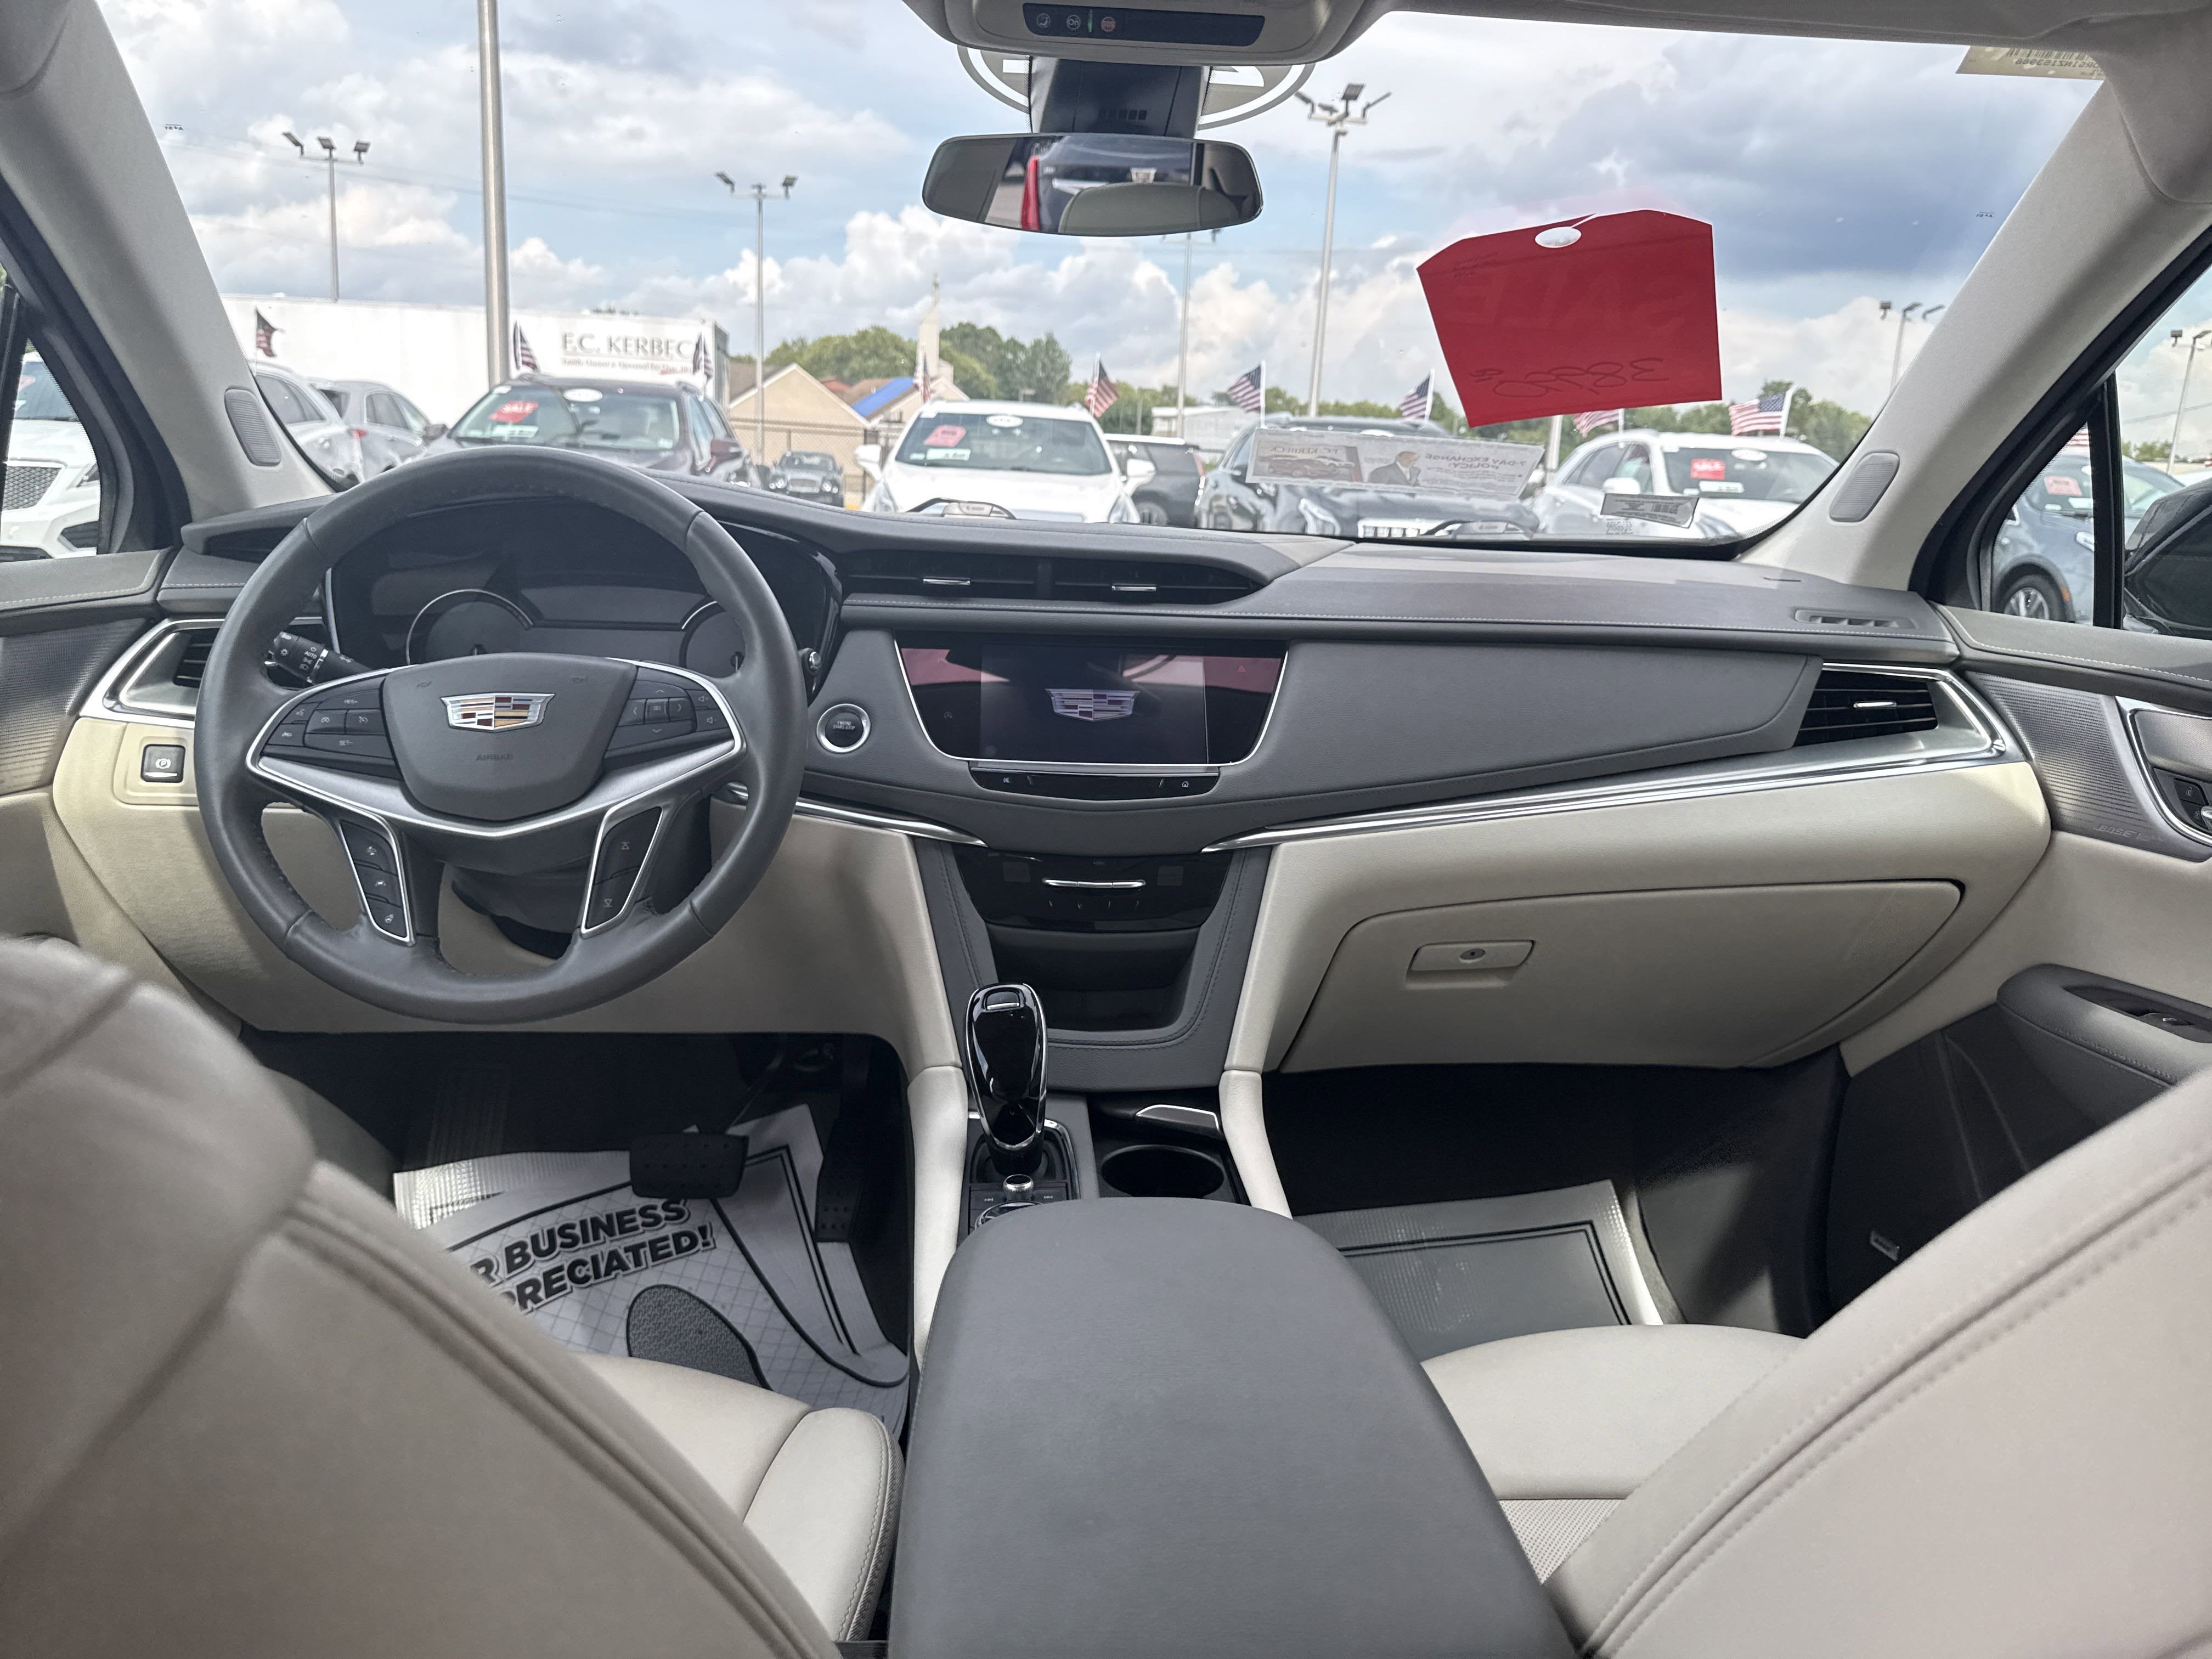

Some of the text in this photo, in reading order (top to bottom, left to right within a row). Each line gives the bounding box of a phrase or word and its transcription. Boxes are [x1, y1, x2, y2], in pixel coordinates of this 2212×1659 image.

[607, 335, 693, 358] KERBEC
[304, 651, 318, 659] AUTO
[2093, 824, 2138, 838] BOSE
[505, 1199, 687, 1274] BUSINESS
